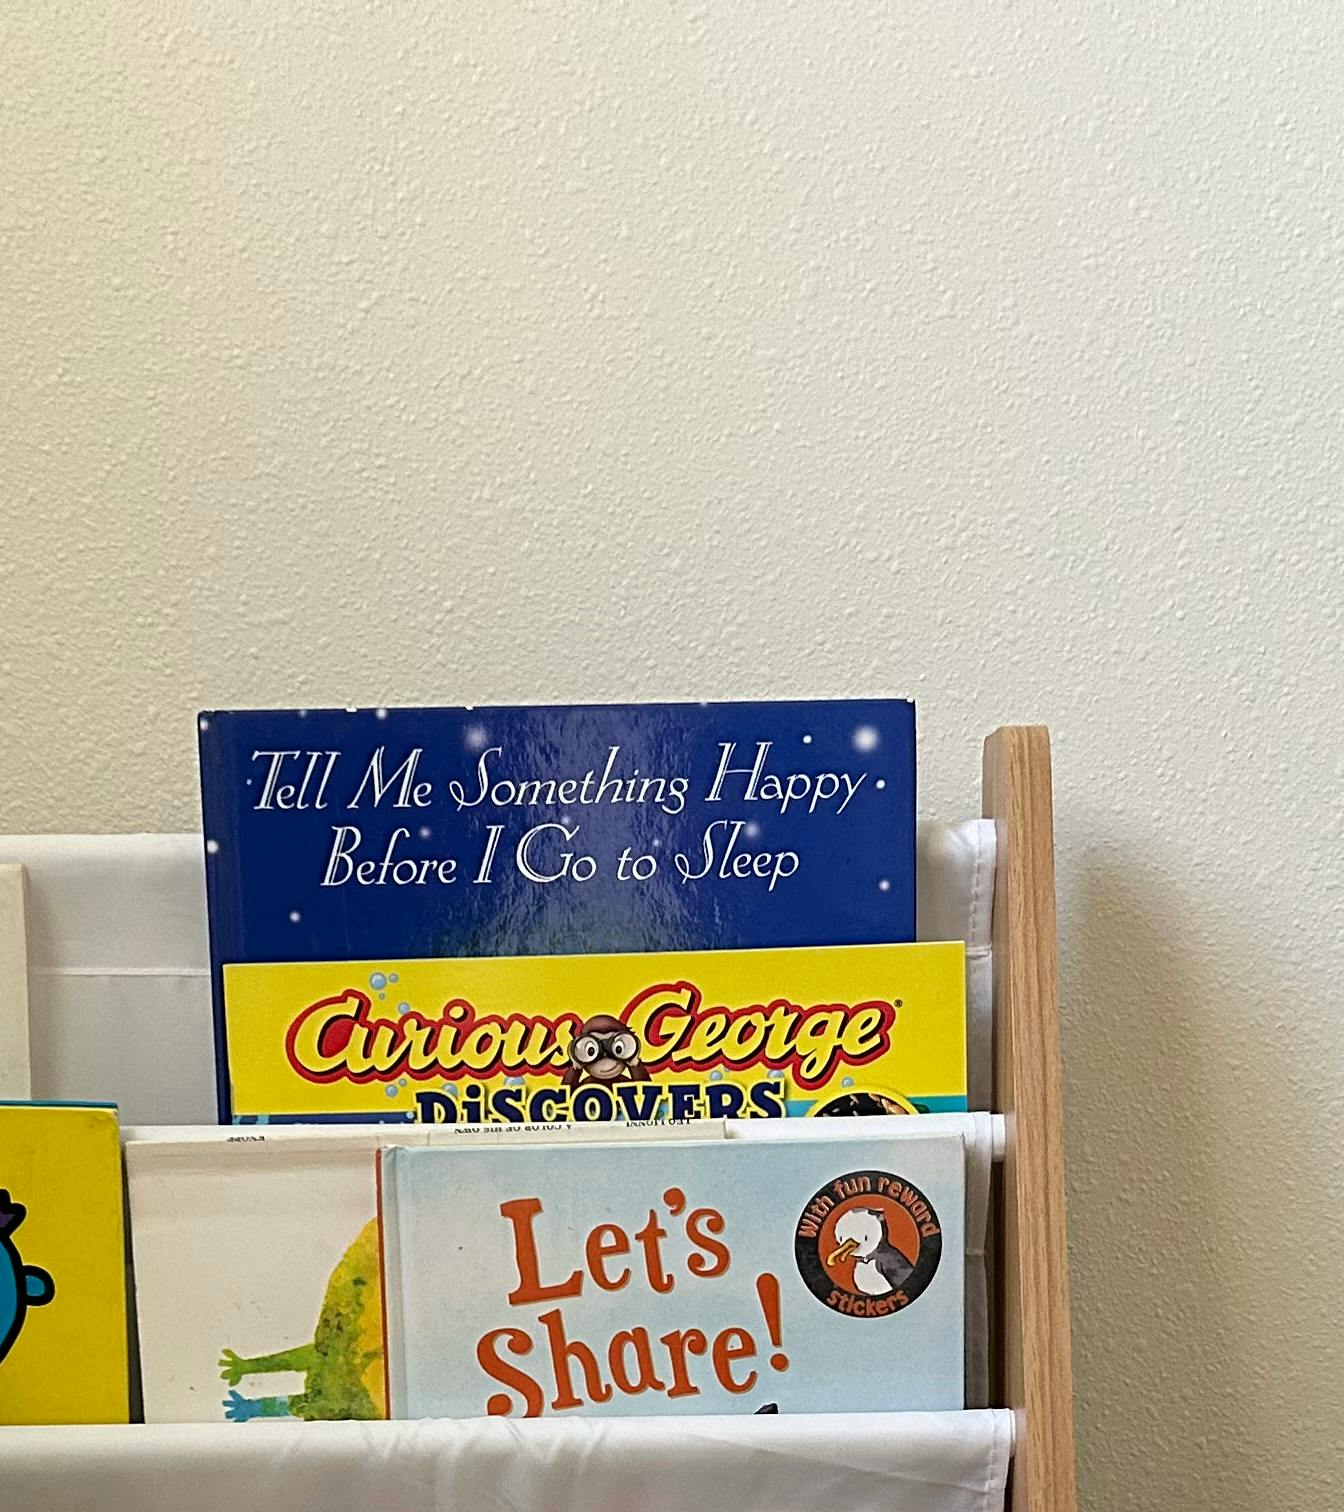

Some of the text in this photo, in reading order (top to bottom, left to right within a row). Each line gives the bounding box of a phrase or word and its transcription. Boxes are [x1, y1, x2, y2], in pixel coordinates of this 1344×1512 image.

[252, 741, 867, 817] Tell Me Something Happy
[320, 819, 801, 890] Before I Go to Sleep
[290, 985, 888, 1084] Curious George
[798, 1175, 941, 1238] With fun reward
[500, 1187, 732, 1307] Let's
[826, 1290, 909, 1316] stickers
[476, 1271, 790, 1418] Share!
